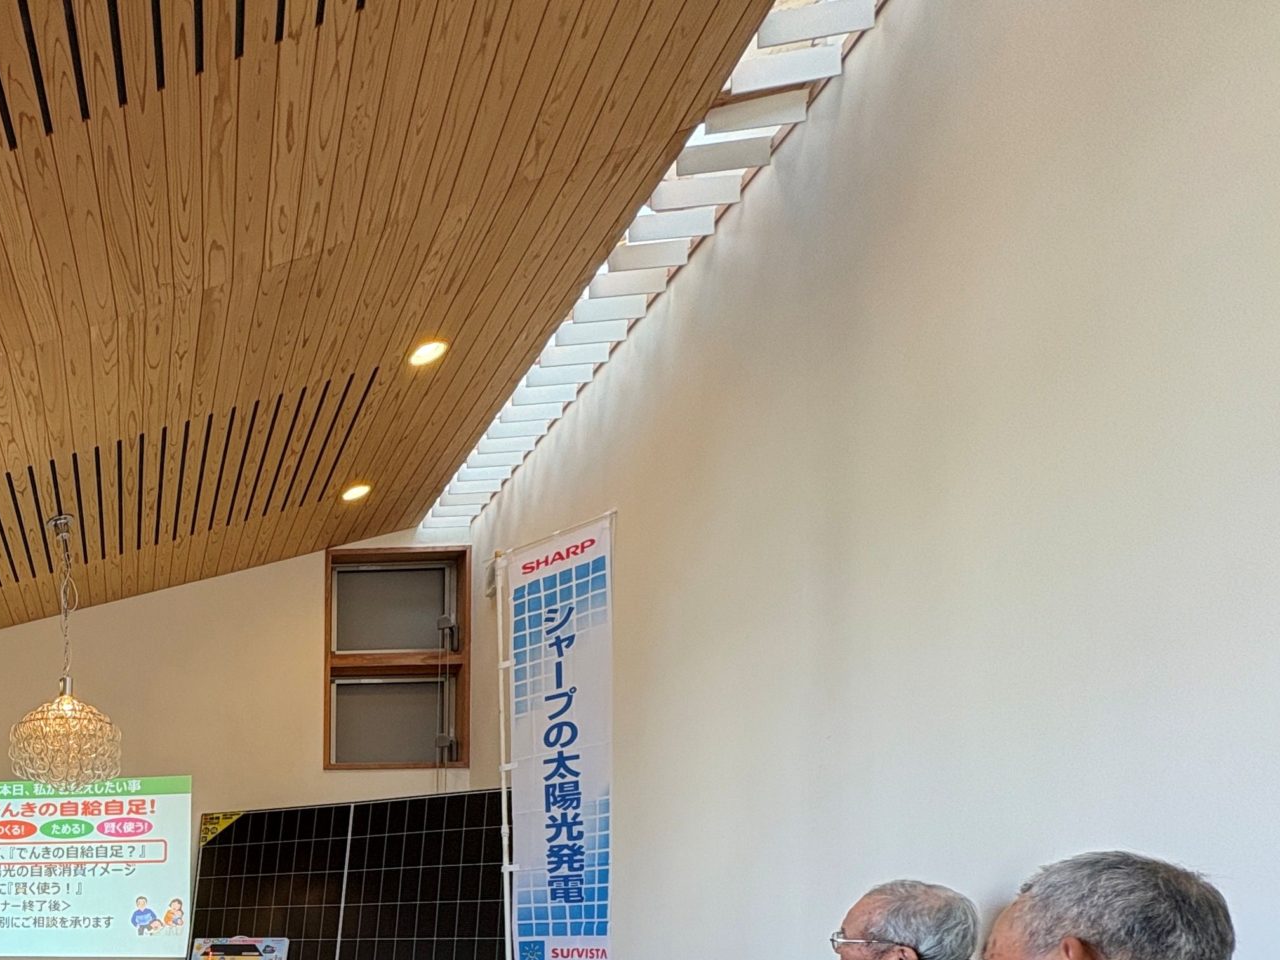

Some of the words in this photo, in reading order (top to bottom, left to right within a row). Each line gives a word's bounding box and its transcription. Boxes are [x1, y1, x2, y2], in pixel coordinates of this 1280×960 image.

[521, 538, 596, 575] SHARP
[543, 606, 585, 903] シャープの太陽光発電
[51, 823, 86, 834] ためる!
[103, 821, 149, 834] 賢く使う!
